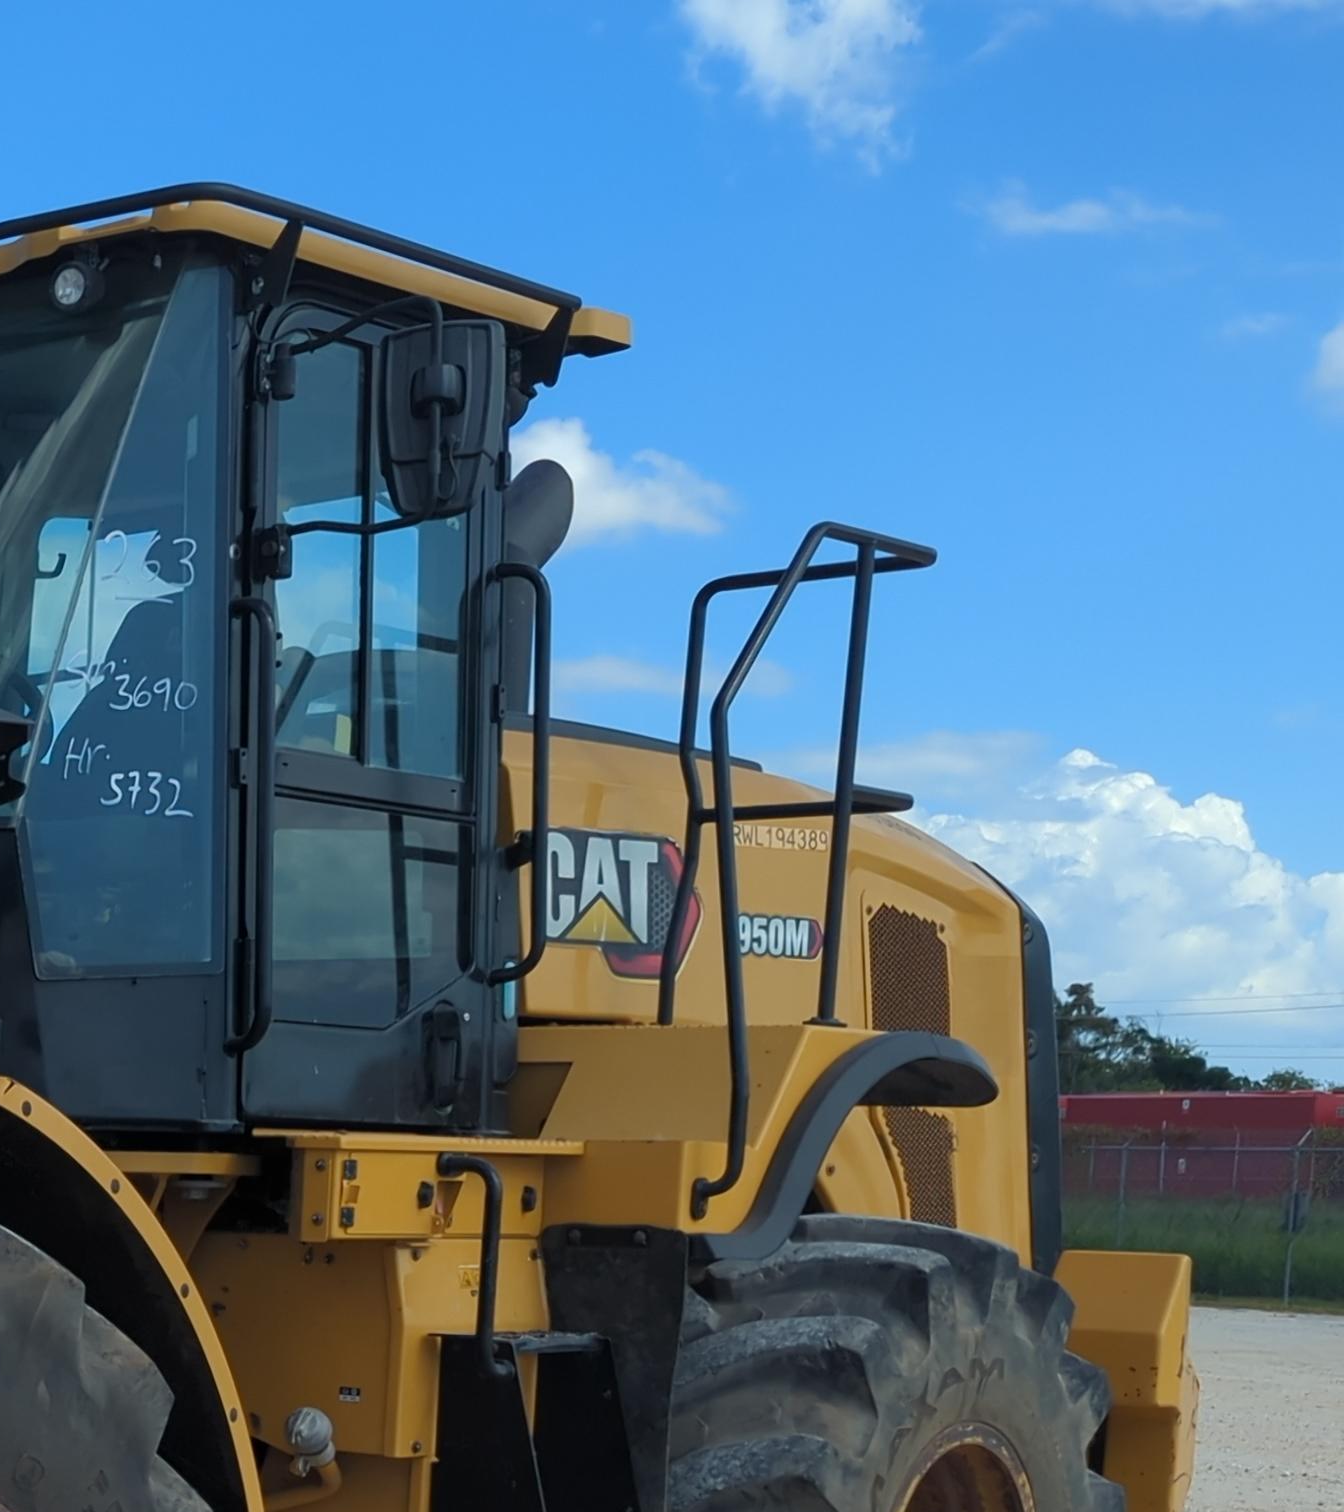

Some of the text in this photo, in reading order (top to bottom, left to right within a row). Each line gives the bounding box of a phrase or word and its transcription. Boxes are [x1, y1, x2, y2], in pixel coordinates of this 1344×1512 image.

[108, 673, 198, 712] 3690
[100, 770, 195, 818] 5732
[732, 823, 829, 853] RWL194389
[545, 831, 659, 945] CAT
[737, 914, 811, 958] 950M
